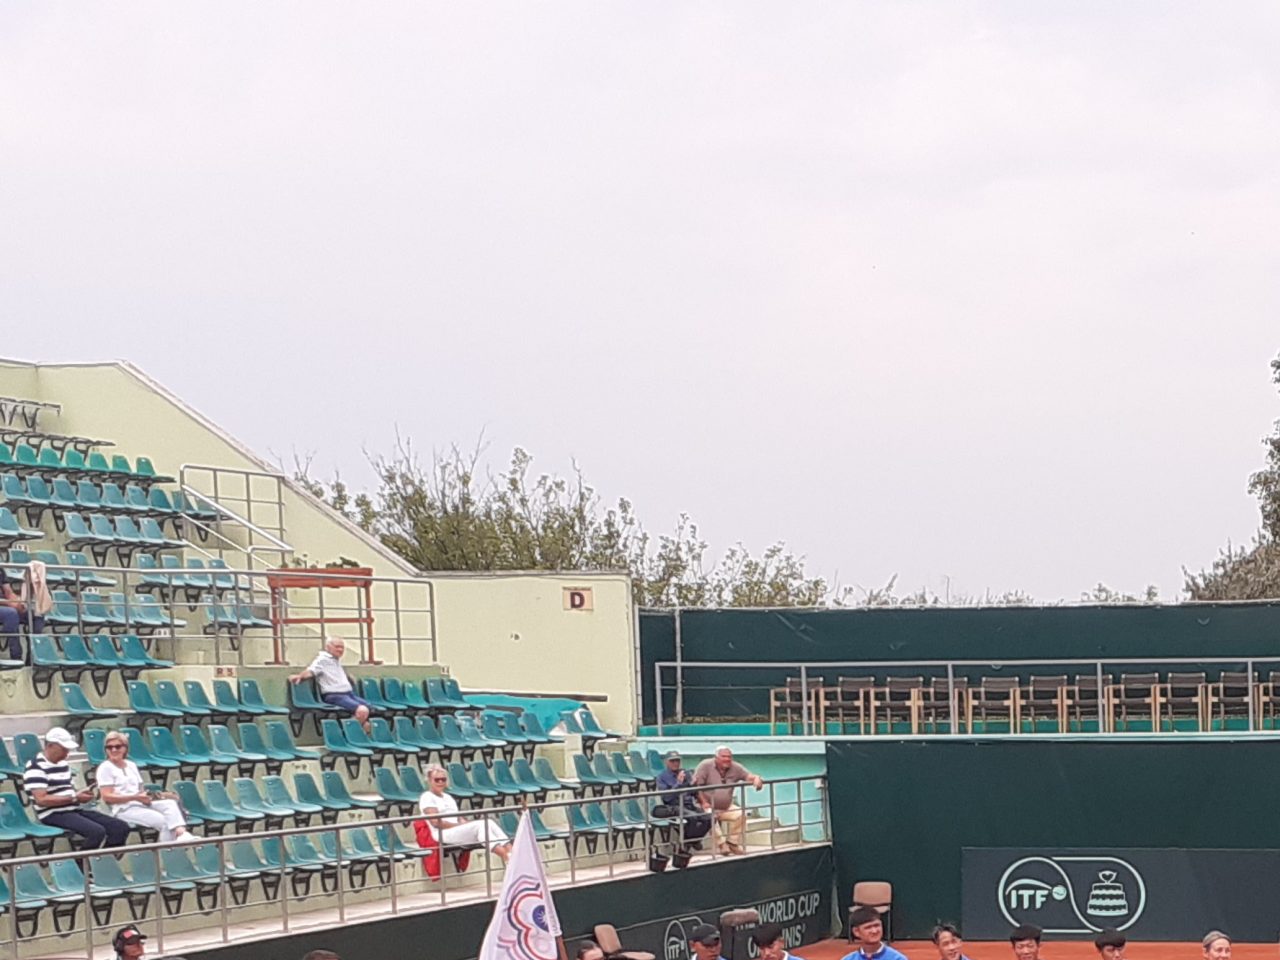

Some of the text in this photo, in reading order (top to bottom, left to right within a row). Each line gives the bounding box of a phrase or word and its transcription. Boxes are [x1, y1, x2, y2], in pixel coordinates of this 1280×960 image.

[570, 592, 585, 609] D
[1010, 889, 1050, 909] ITF
[758, 893, 820, 925] WORLD CUP
[668, 944, 680, 960] ITF
